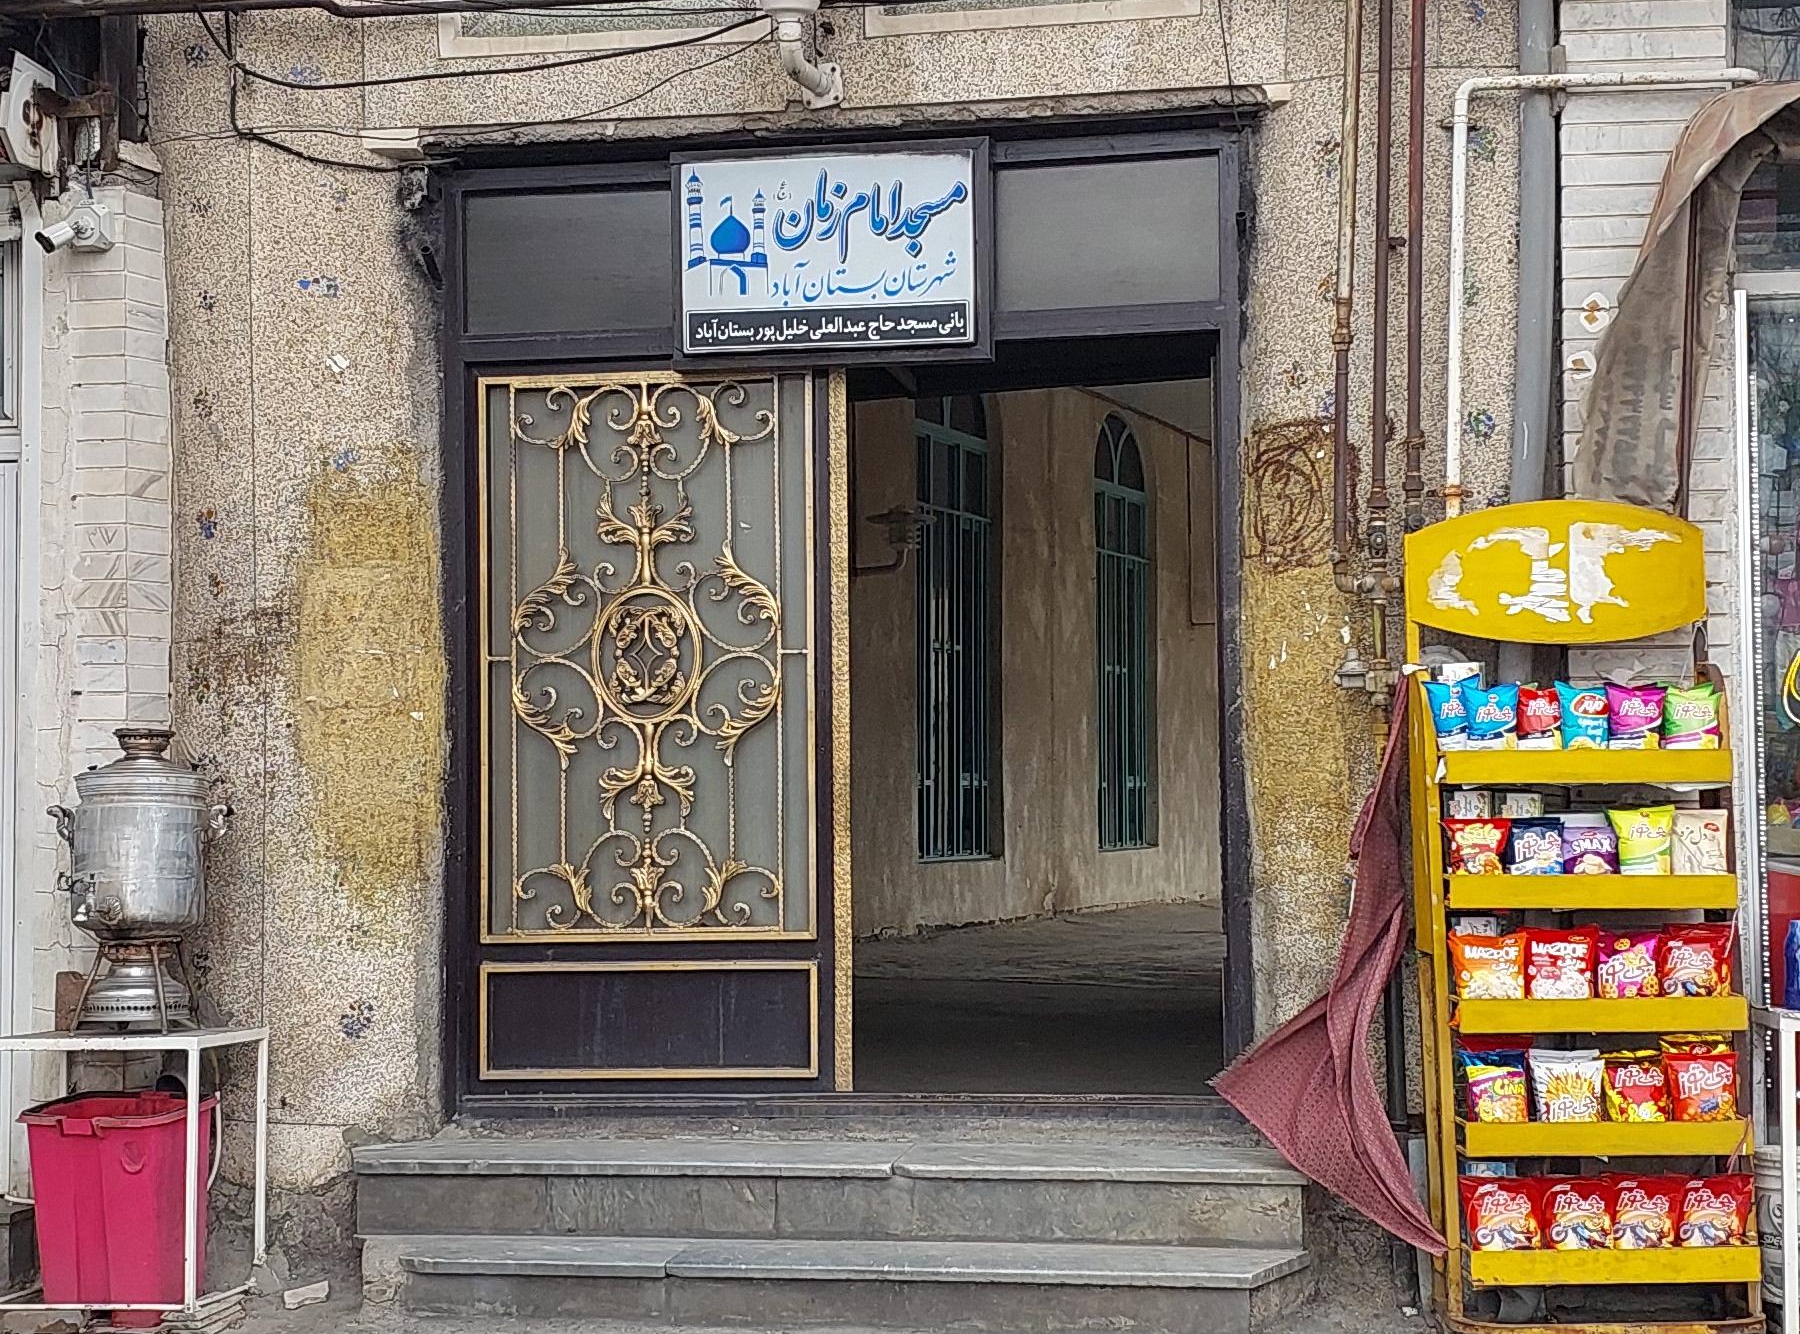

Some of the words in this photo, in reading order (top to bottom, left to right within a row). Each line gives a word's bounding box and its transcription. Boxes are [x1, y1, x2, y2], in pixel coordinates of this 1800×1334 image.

[772, 167, 848, 252] زمان
[839, 179, 902, 264] امام
[886, 181, 968, 258] مسجد
[771, 259, 811, 306] آباد
[803, 268, 887, 302] بستان
[884, 251, 957, 297] شهرستان
[810, 316, 866, 340] عبدالعلی
[868, 315, 895, 339] حاج
[897, 317, 937, 335] مسجد
[939, 311, 964, 334] بانی
